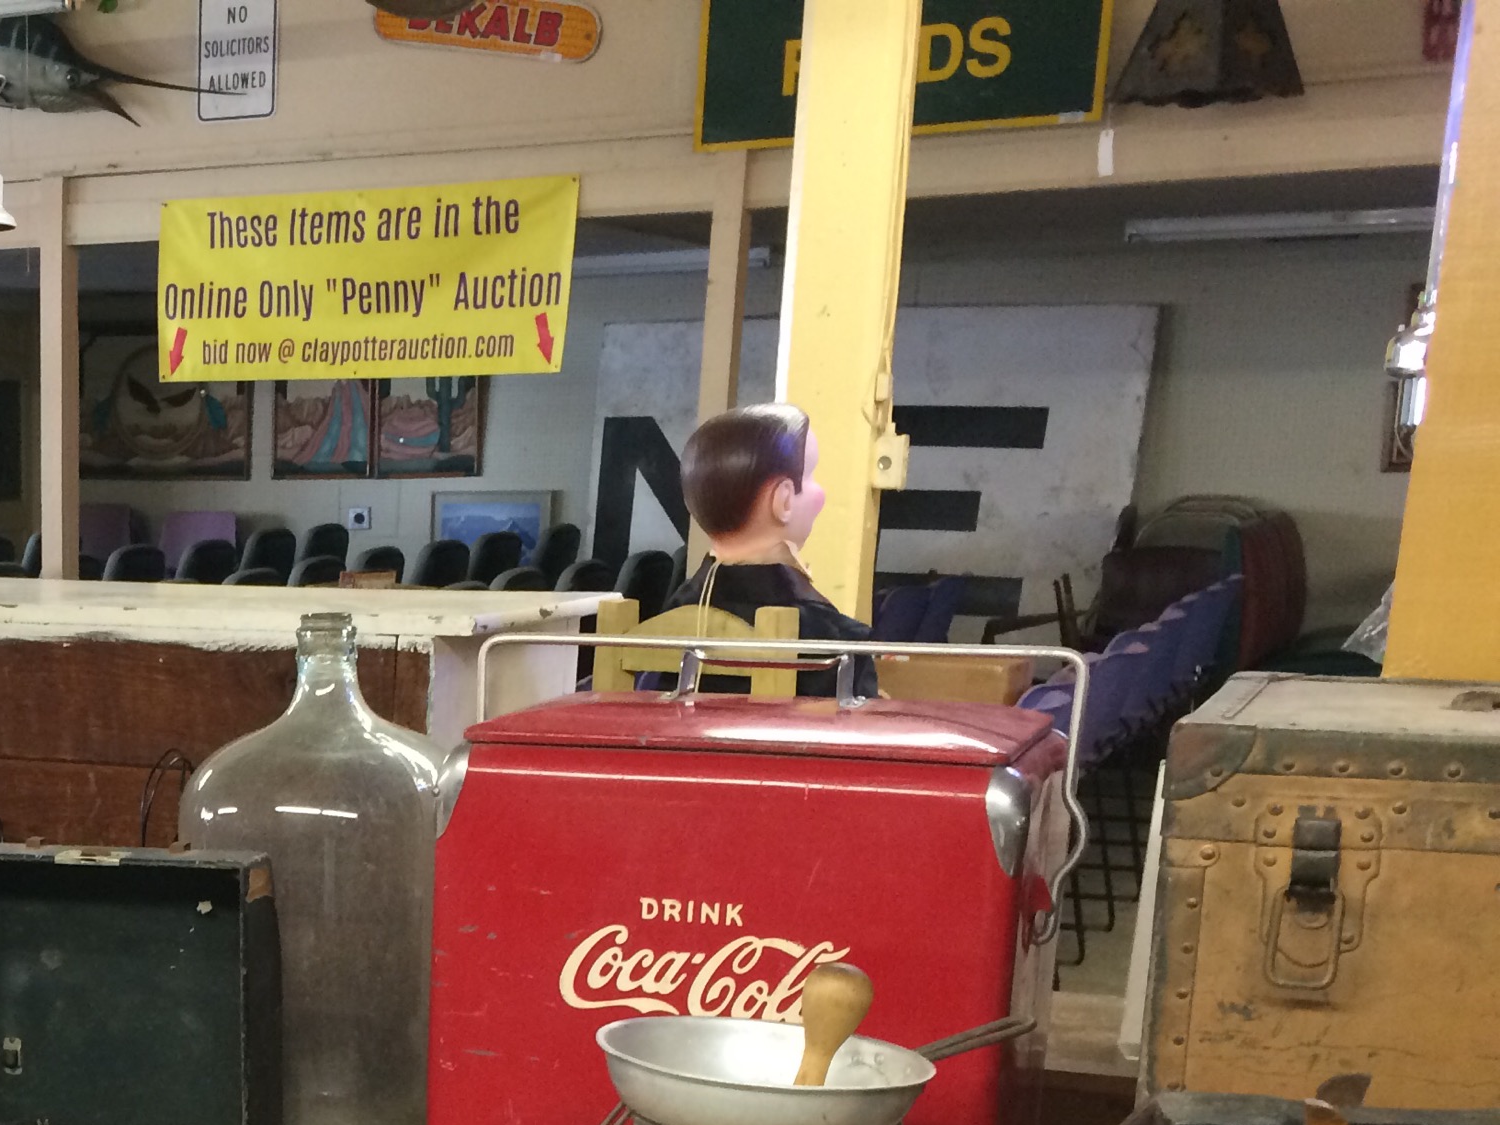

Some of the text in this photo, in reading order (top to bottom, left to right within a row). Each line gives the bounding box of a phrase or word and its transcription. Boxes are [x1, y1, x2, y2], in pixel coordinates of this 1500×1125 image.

[226, 6, 248, 24] NO
[204, 36, 270, 58] SOLICITORS
[208, 71, 266, 93] ALLOWED
[207, 196, 520, 249] These Items are in the
[164, 267, 562, 321] Online Only "Penny" Auction
[202, 333, 515, 366] bid now @ claypotterauction.com
[639, 896, 744, 927] DRINK
